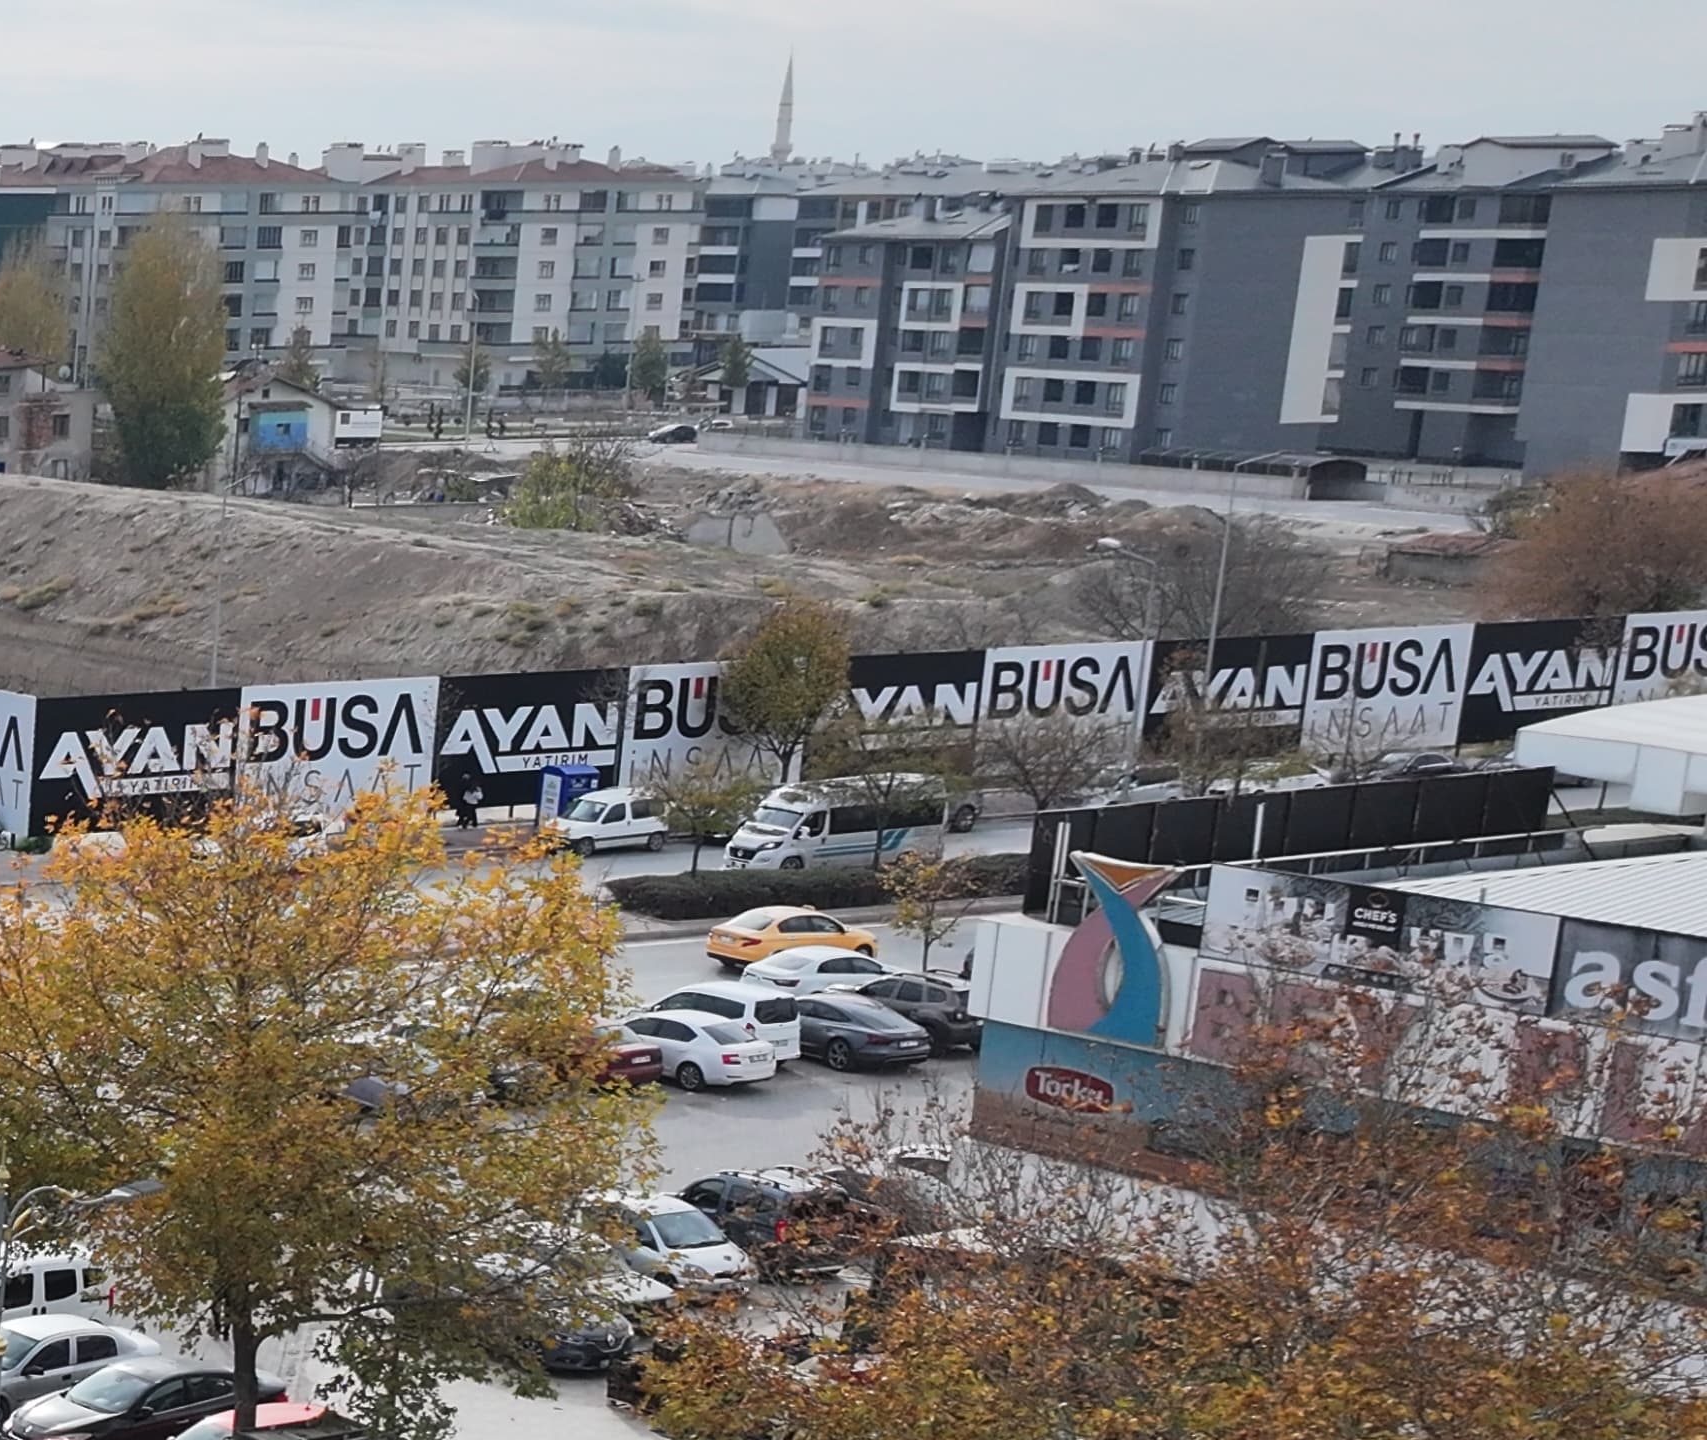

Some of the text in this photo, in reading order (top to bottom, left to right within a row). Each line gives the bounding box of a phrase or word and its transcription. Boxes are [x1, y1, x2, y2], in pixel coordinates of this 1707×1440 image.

[851, 656, 1136, 726] YAN BÜSA
[1149, 638, 1456, 714] AYAN BÜSA
[1467, 648, 1617, 712] AYAN
[39, 693, 424, 799] AYAN BÜSA
[440, 703, 618, 774] AYAN
[521, 753, 588, 769] YATIRIM
[1354, 907, 1398, 924] CHEF'S
